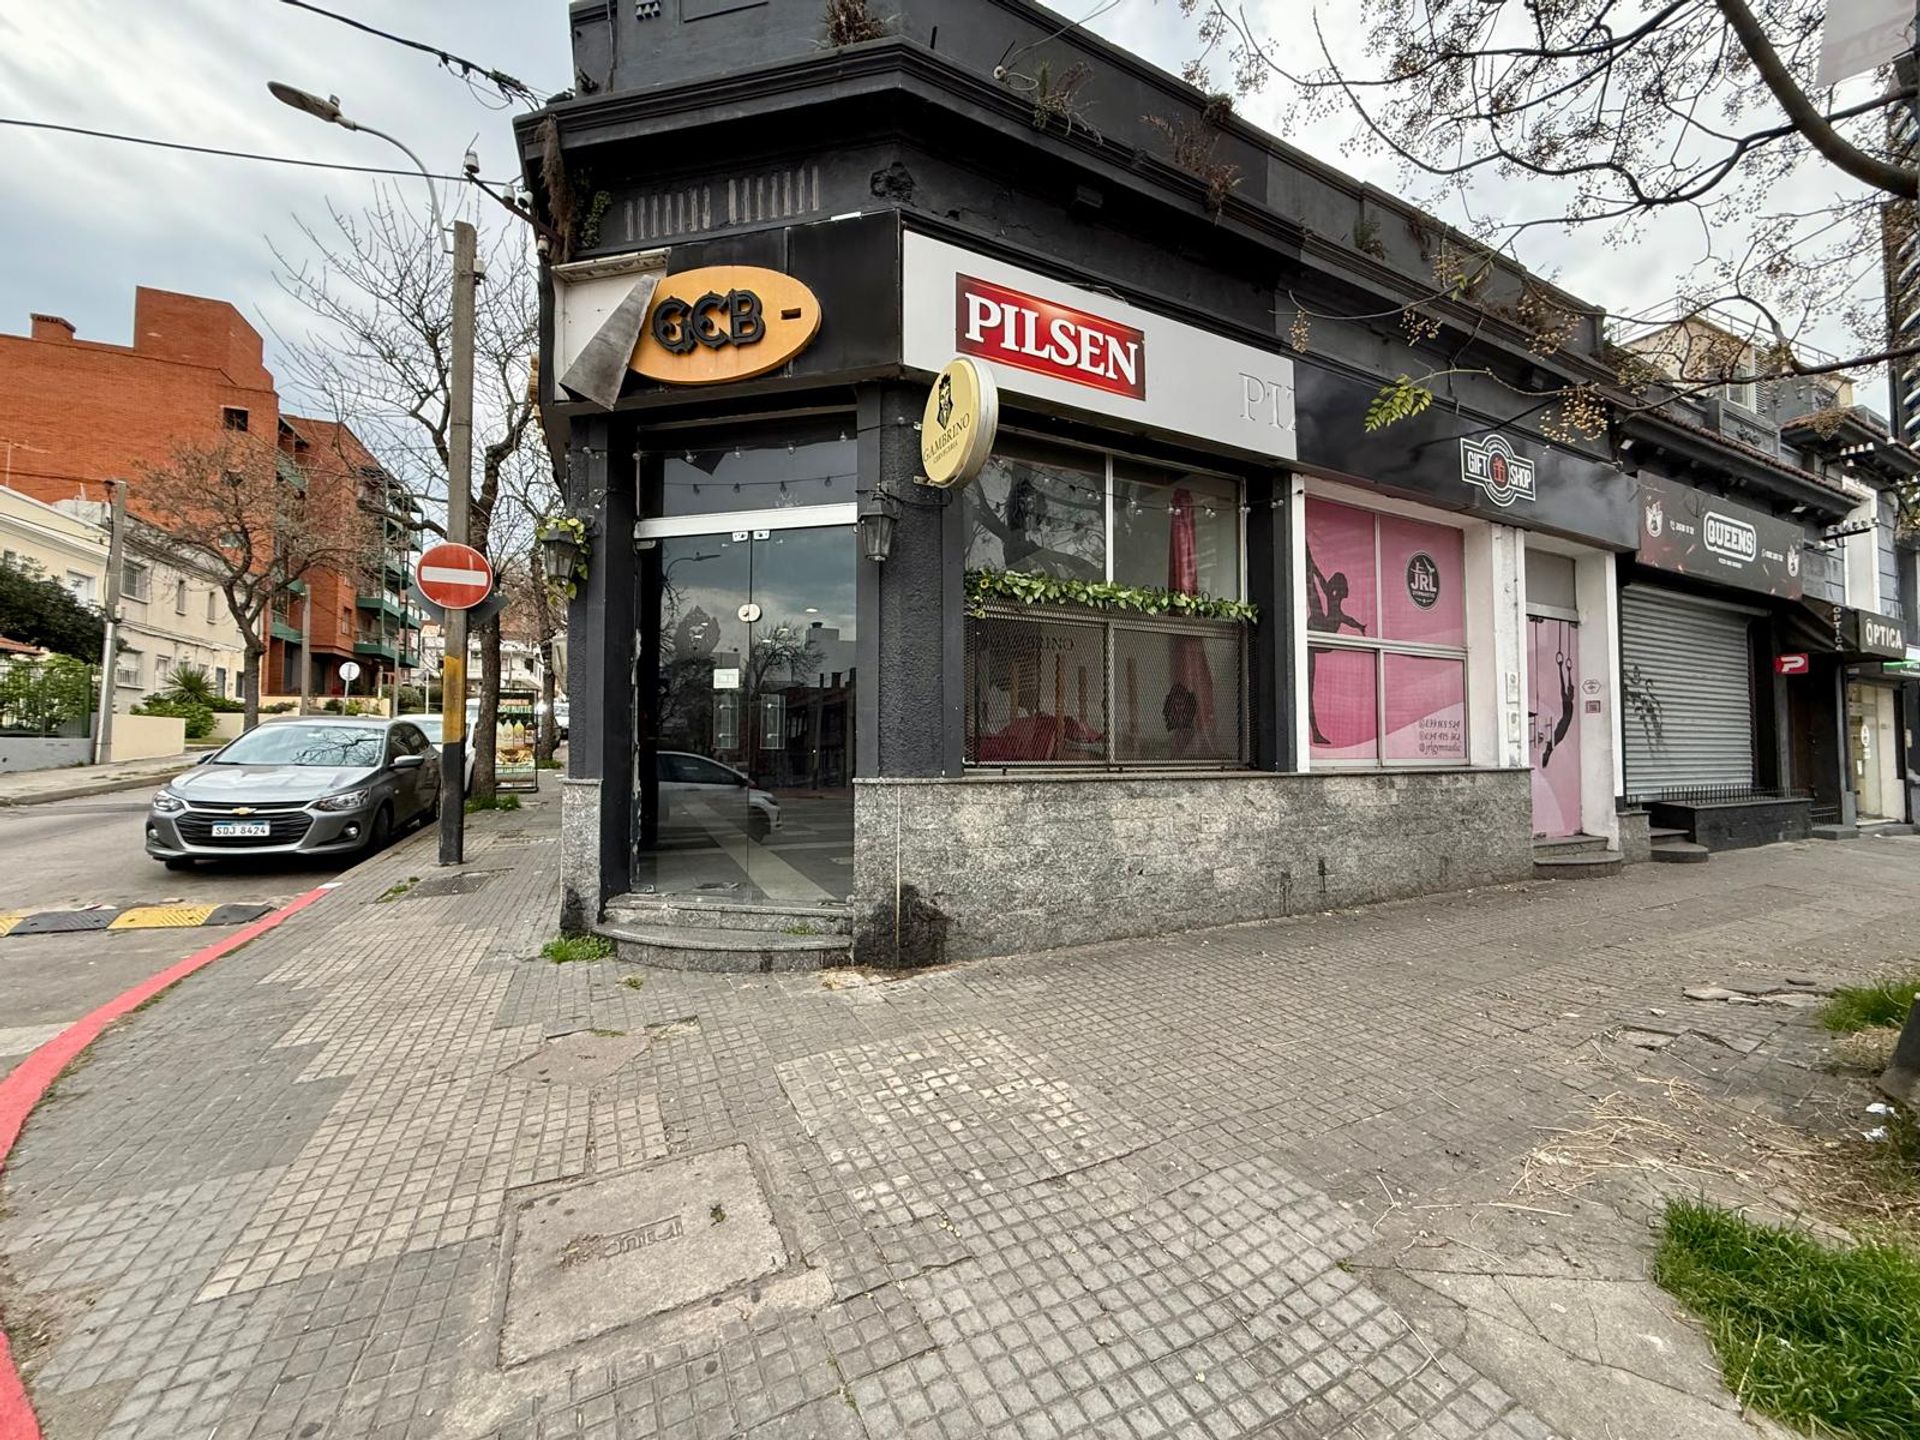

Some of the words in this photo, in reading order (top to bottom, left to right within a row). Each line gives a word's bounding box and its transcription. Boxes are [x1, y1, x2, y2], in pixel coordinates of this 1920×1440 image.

[652, 288, 766, 354] GCB
[964, 291, 1138, 386] PILSEN
[924, 412, 970, 463] GAMBRINO
[1467, 451, 1488, 477] GIFT
[1510, 465, 1532, 489] SHOP
[1707, 519, 1754, 554] QUEENS
[1410, 573, 1437, 592] JRL
[1833, 607, 1844, 651] OPTICA
[240, 825, 266, 835] 8424
